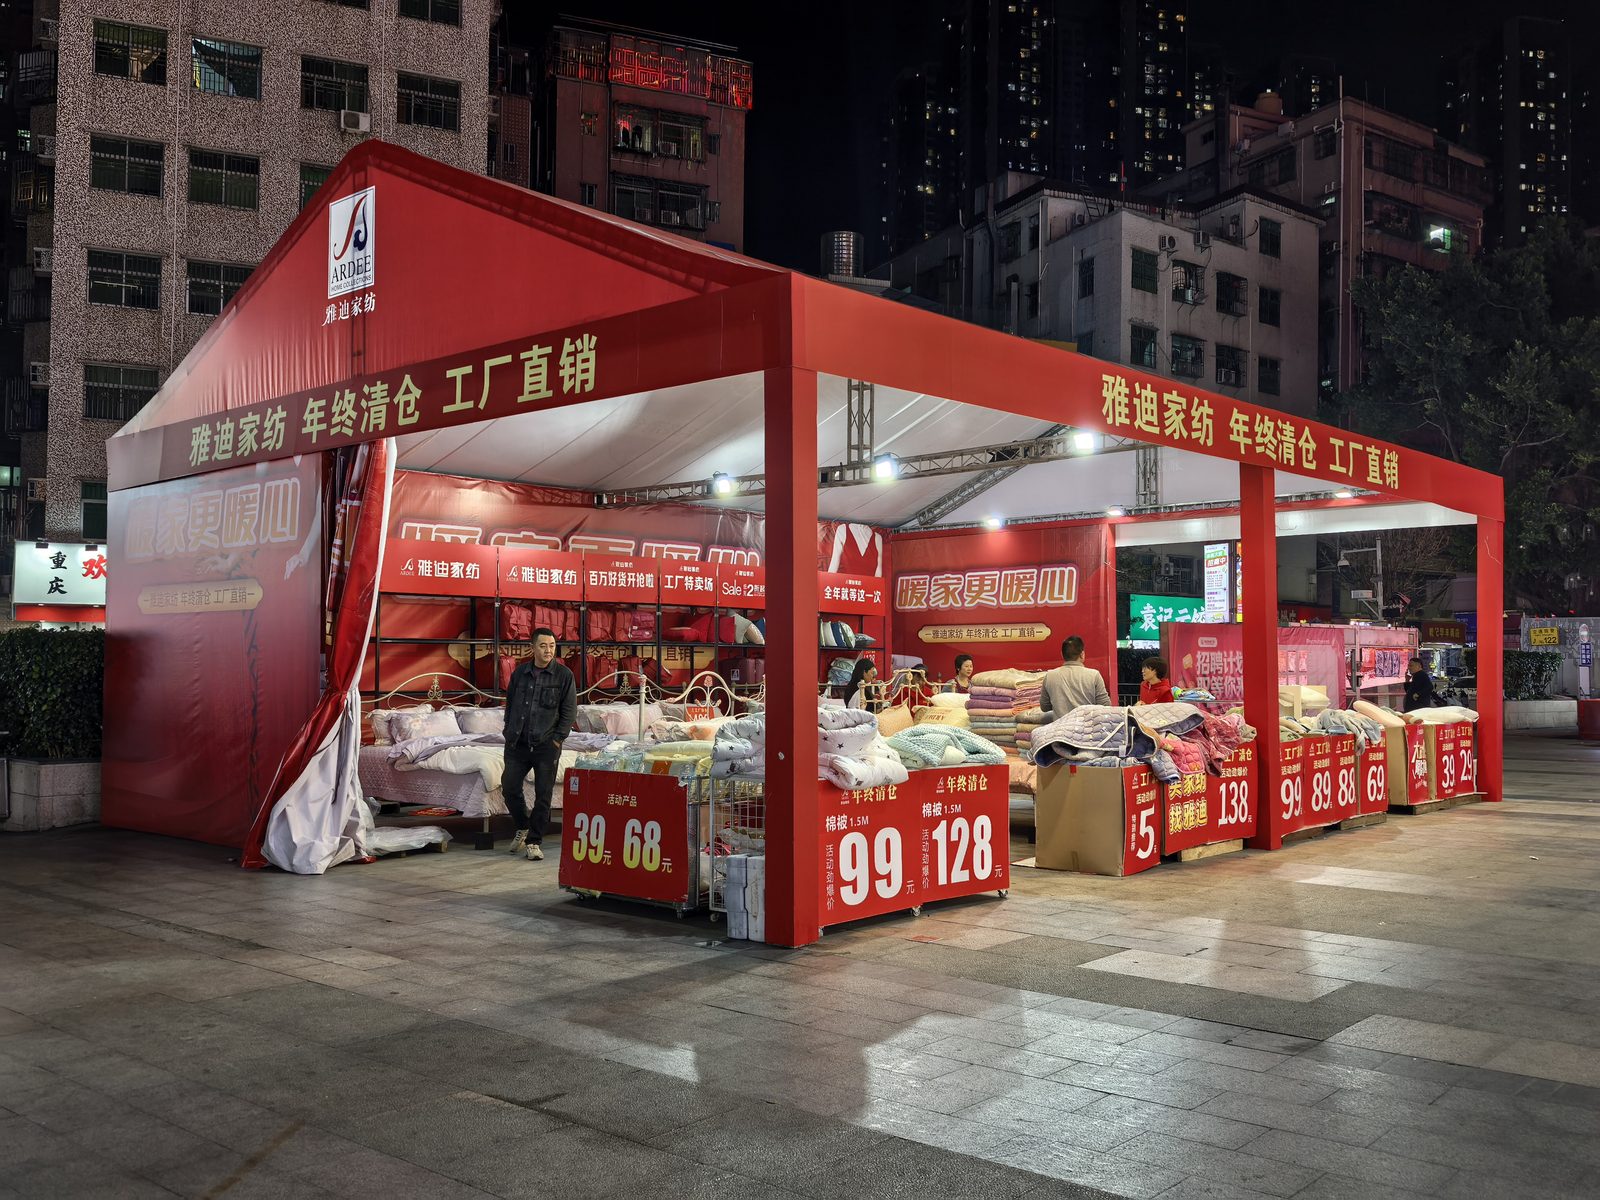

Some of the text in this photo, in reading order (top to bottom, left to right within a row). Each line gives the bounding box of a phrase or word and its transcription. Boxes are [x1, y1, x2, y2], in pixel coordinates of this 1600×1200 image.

[331, 255, 371, 283] ARDEE
[331, 275, 372, 292] HOME COLLECTIONS
[322, 292, 376, 326] 雅迪家纺
[188, 333, 599, 467] 雅迪家纺 年终清仓 工厂直销
[1102, 373, 1399, 490] 雅迪家纺 年终清仓 工厂直销
[47, 551, 68, 594] 重庆
[418, 559, 480, 579] 雅迪家纺
[521, 566, 577, 585] 雅迪家纺
[589, 570, 654, 588] 百万好货开抢啦
[664, 575, 713, 592] 工厂特卖场
[214, 587, 247, 604] 工厂直销
[722, 579, 742, 596] Sale
[824, 585, 882, 603] 全年就等这一次
[896, 566, 1076, 609] 暖家更暖心
[932, 627, 1035, 640] 雅迪家纺 年终清仓 工厂直销
[1442, 754, 1455, 788] 39
[1460, 749, 1472, 781] 29
[947, 773, 988, 793] 年终清仓
[1281, 776, 1301, 819] 99
[1311, 770, 1331, 811] 89
[1338, 767, 1355, 807] 88
[1367, 764, 1385, 802] 69
[607, 793, 637, 808] 活动产品
[922, 802, 961, 818] 棉被 1.5M
[1169, 797, 1208, 835] 找雅迪
[1218, 780, 1248, 827] 138
[572, 812, 606, 864] 39
[826, 813, 869, 832] 棉被 1.5M
[1136, 802, 1155, 859] 5
[622, 818, 661, 872] 68
[932, 814, 1003, 886] 128 元
[825, 843, 835, 911] 活动劲爆价
[839, 826, 915, 906] 99 元
